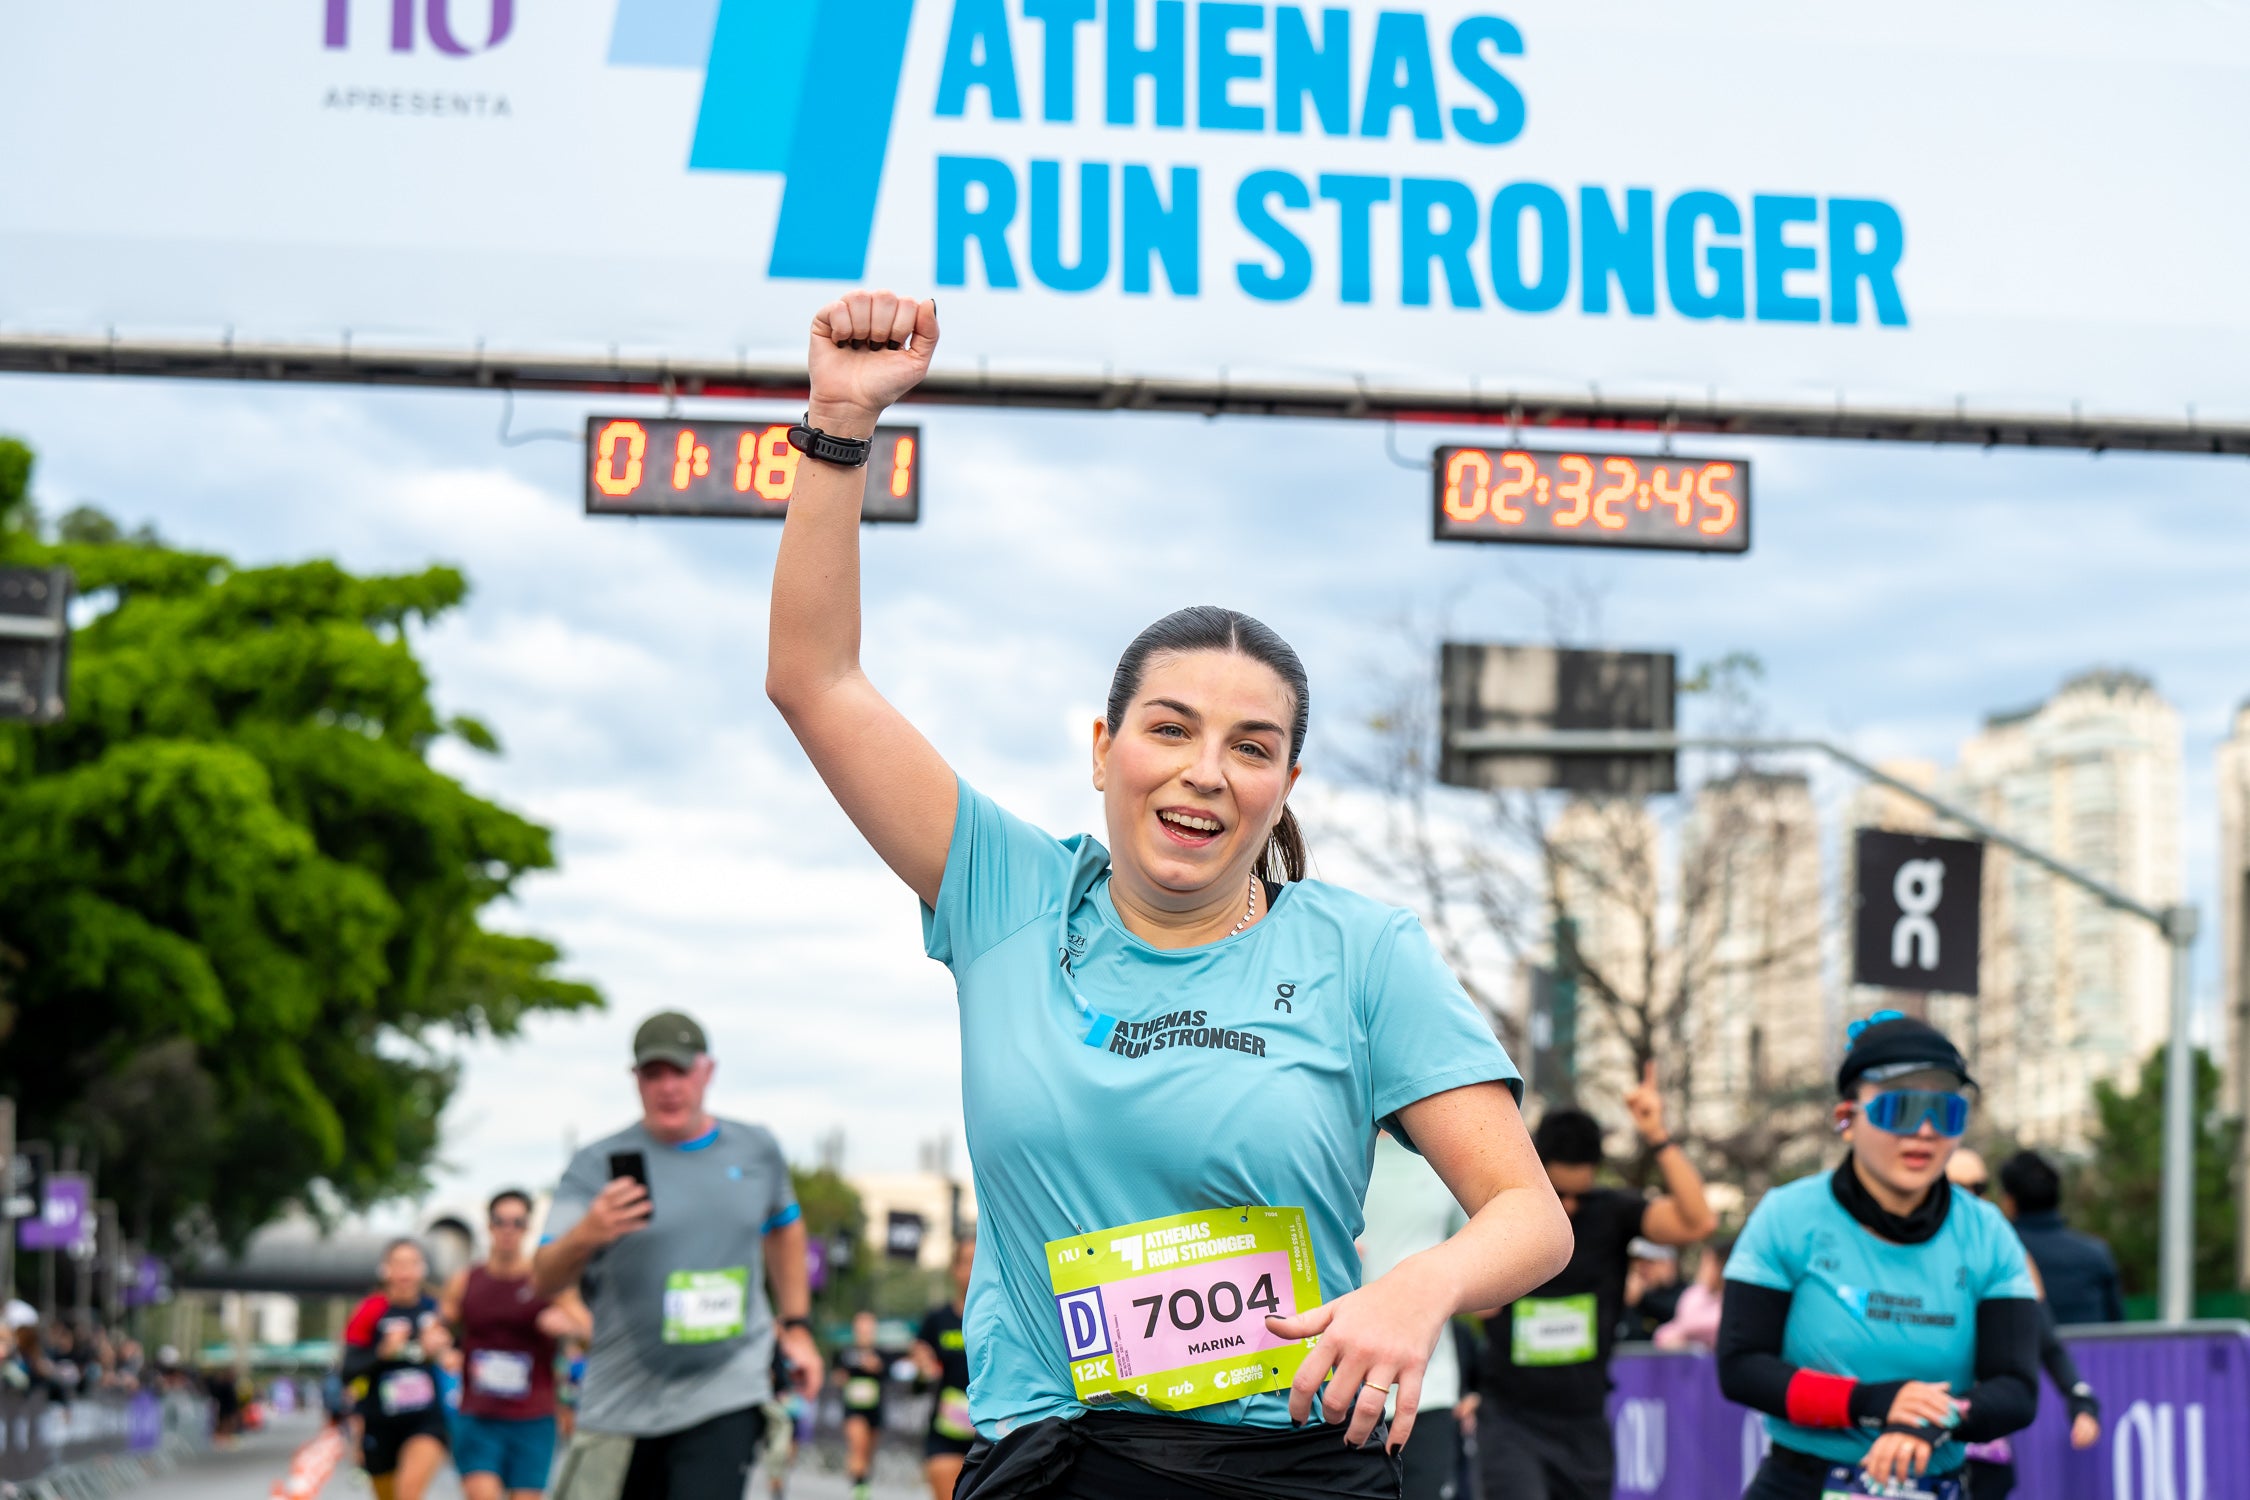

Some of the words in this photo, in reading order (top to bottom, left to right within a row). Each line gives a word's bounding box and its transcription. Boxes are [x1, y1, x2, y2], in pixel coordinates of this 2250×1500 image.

[933, 0, 1527, 146] ATHENAS
[323, 87, 512, 117] APRESENTA
[934, 154, 1201, 297] RUN
[1234, 167, 1911, 328] STRONGER
[1443, 448, 1739, 537] 02:32:45
[1114, 1010, 1208, 1040] ATHENAS
[1108, 1032, 1151, 1059] RUN
[1152, 1027, 1266, 1058] STRONGER
[1145, 1222, 1210, 1250] ATHENAS
[1147, 1246, 1178, 1269] RUN
[1179, 1233, 1257, 1262] STRONGER
[1132, 1273, 1280, 1340] 7004
[1068, 1300, 1097, 1350] D
[1187, 1334, 1246, 1356] MARINA
[1074, 1359, 1112, 1383] 12K
[1230, 1371, 1264, 1385] SPORTS
[1167, 1380, 1195, 1397] rvb
